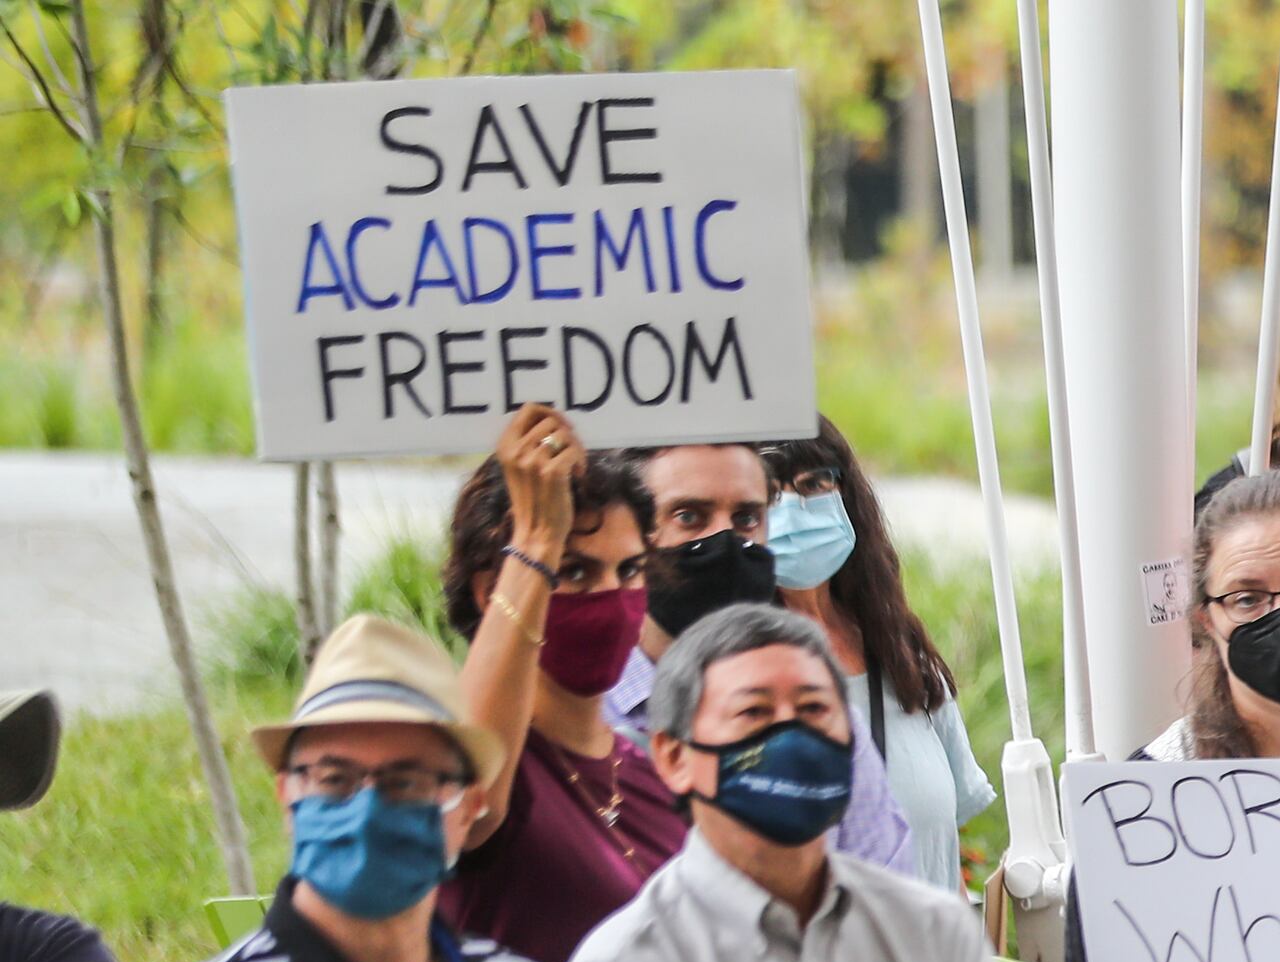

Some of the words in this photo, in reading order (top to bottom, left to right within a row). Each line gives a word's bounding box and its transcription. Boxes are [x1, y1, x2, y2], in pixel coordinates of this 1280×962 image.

[380, 96, 662, 195] SAVE
[296, 199, 745, 313] ACADEMIC
[318, 317, 753, 422] FREEDOM
